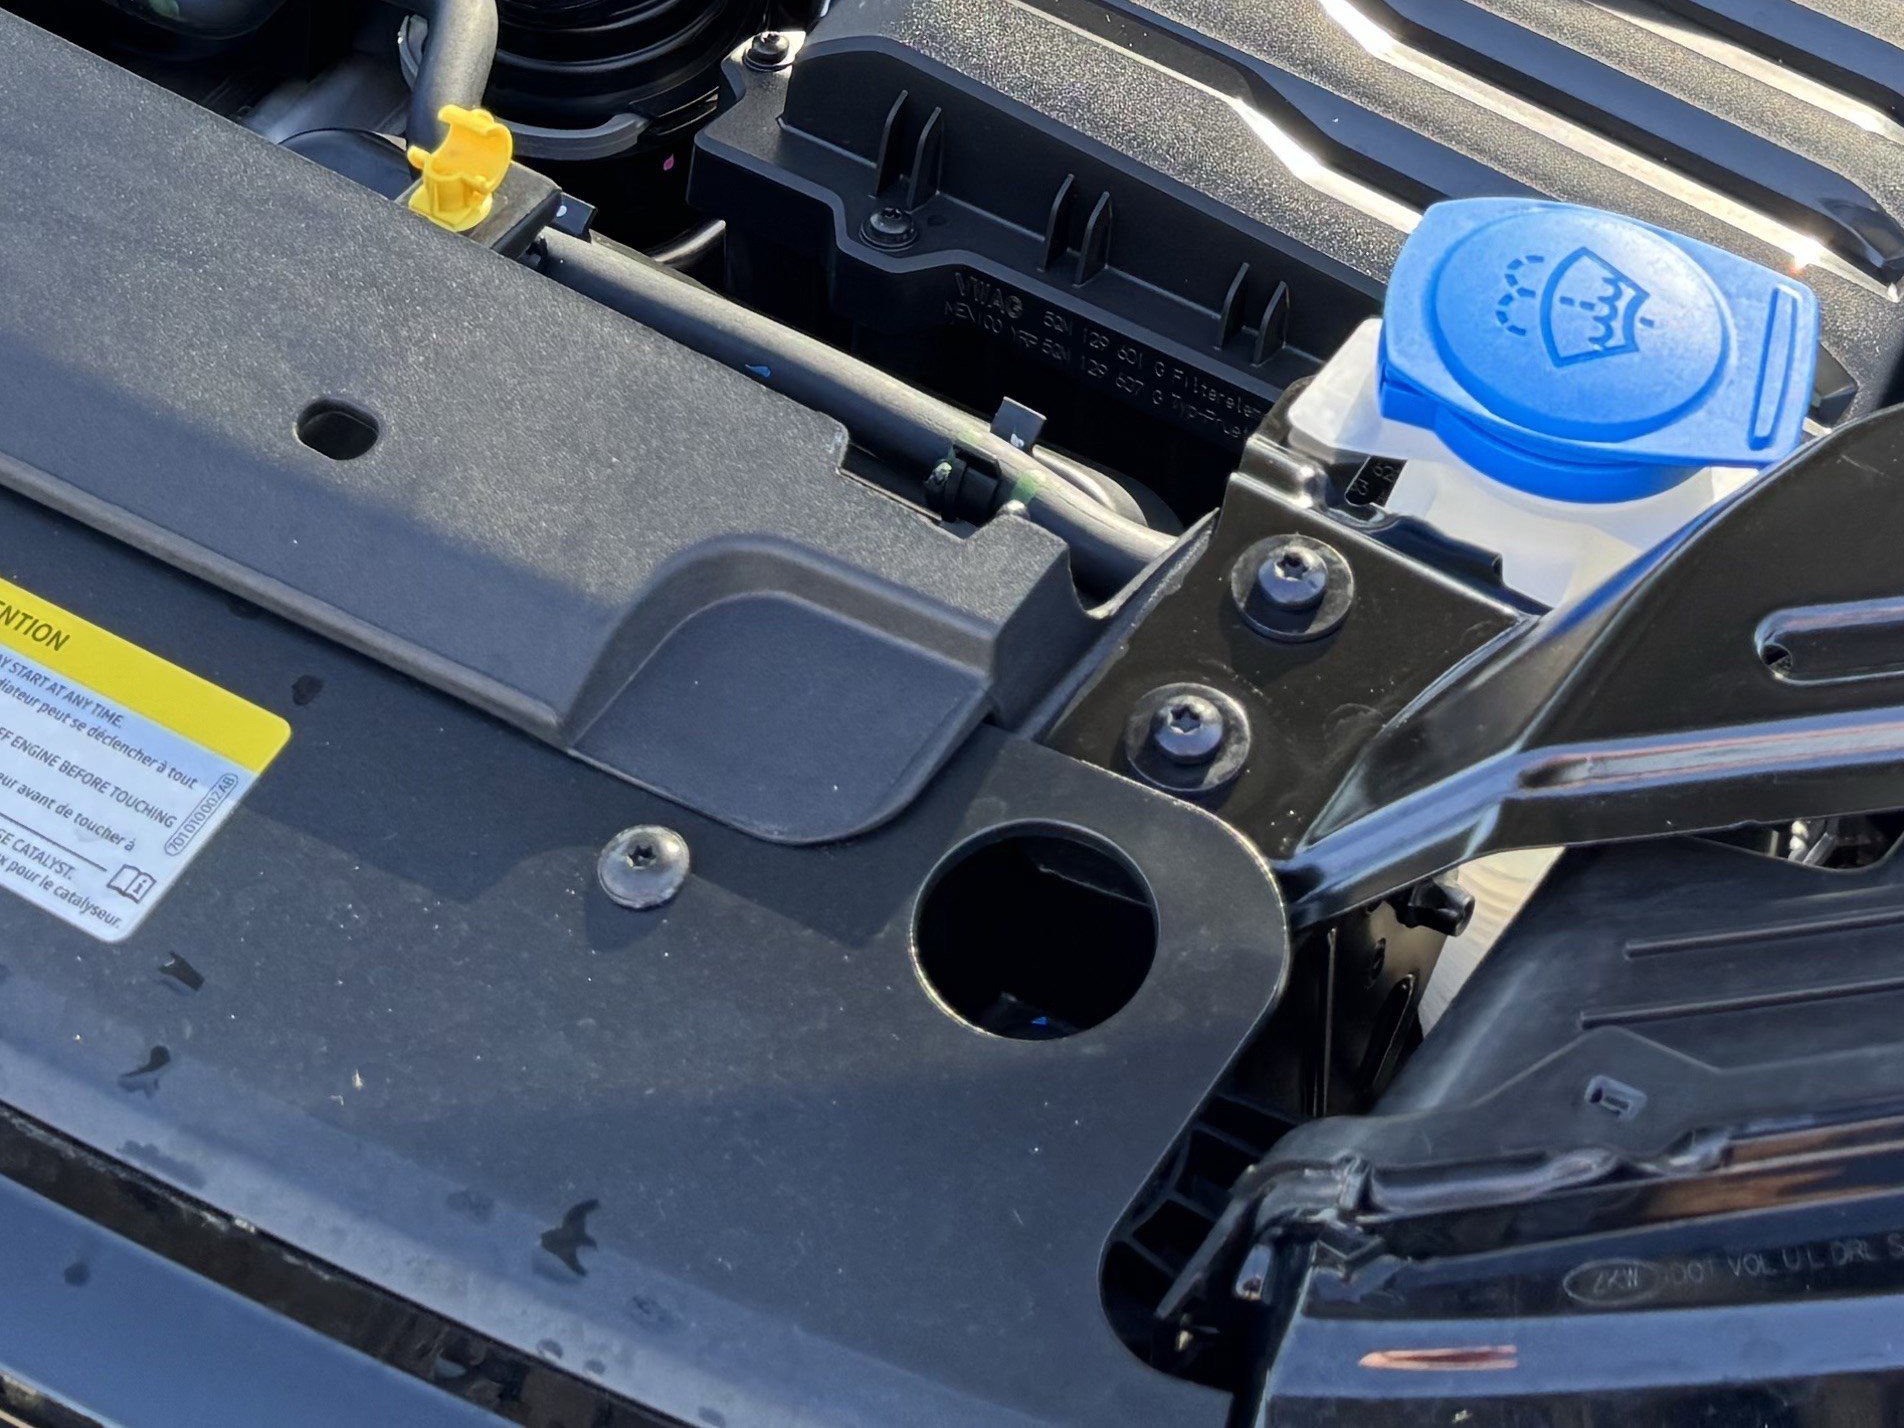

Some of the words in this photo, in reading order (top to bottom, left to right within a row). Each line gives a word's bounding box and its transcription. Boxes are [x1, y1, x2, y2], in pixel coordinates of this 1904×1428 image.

[7, 661, 49, 688] START
[43, 680, 67, 697] AT
[60, 688, 93, 711] ANY
[88, 703, 128, 729] TIME.
[35, 700, 72, 726] peut
[67, 718, 87, 732] se
[84, 723, 161, 769] déclencher
[154, 759, 171, 774] à
[165, 767, 200, 790] tout
[8, 734, 62, 768] ENGINE
[56, 759, 112, 795] BEFORE
[105, 784, 178, 829] TOUCHING
[14, 782, 58, 810] avant
[53, 800, 78, 819] de
[71, 810, 129, 847] toucher
[122, 837, 139, 852] à
[9, 837, 79, 881] CATALYST.
[3, 859, 40, 885] pour
[37, 874, 57, 891] le
[48, 881, 127, 932] catalyseur.
